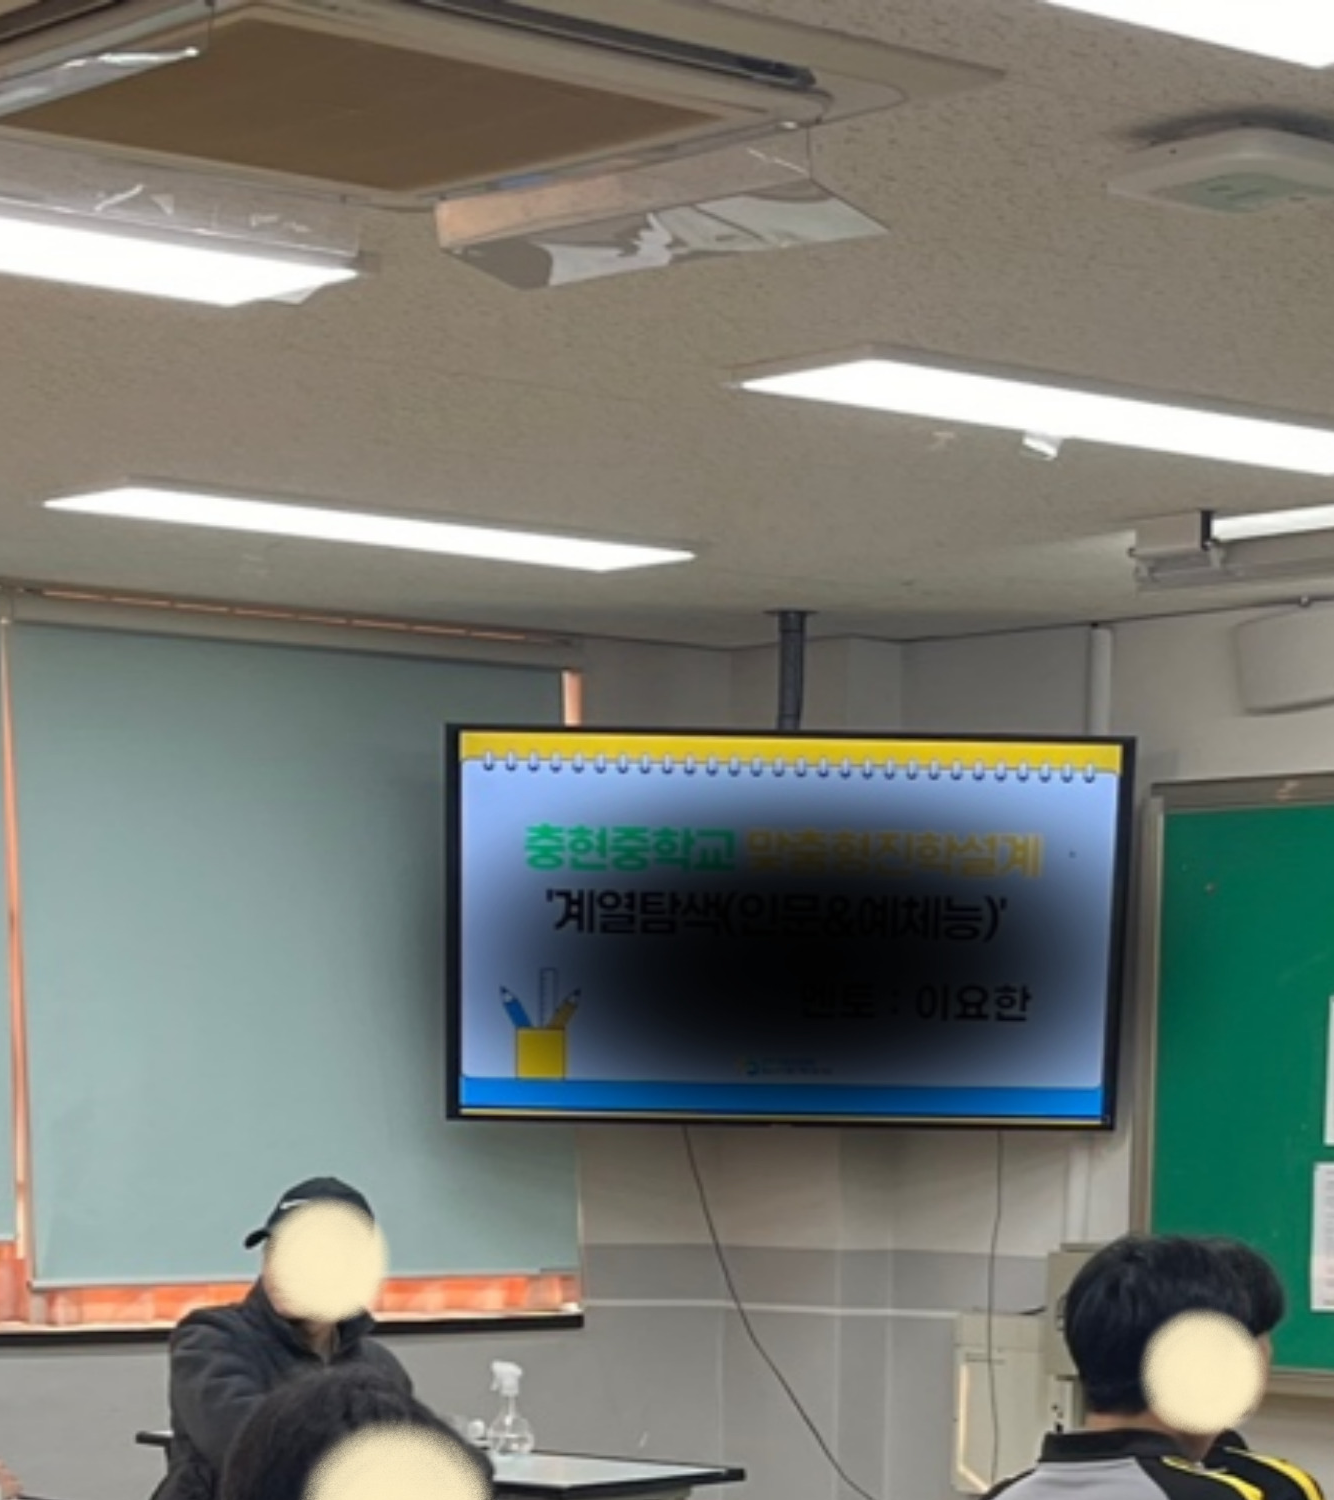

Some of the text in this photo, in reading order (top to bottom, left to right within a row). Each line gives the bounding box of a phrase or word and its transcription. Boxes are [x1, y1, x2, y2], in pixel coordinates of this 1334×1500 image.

[524, 824, 1043, 879] 충현중학교 맞춤형진학설계
[915, 984, 1031, 1023] 이요한
